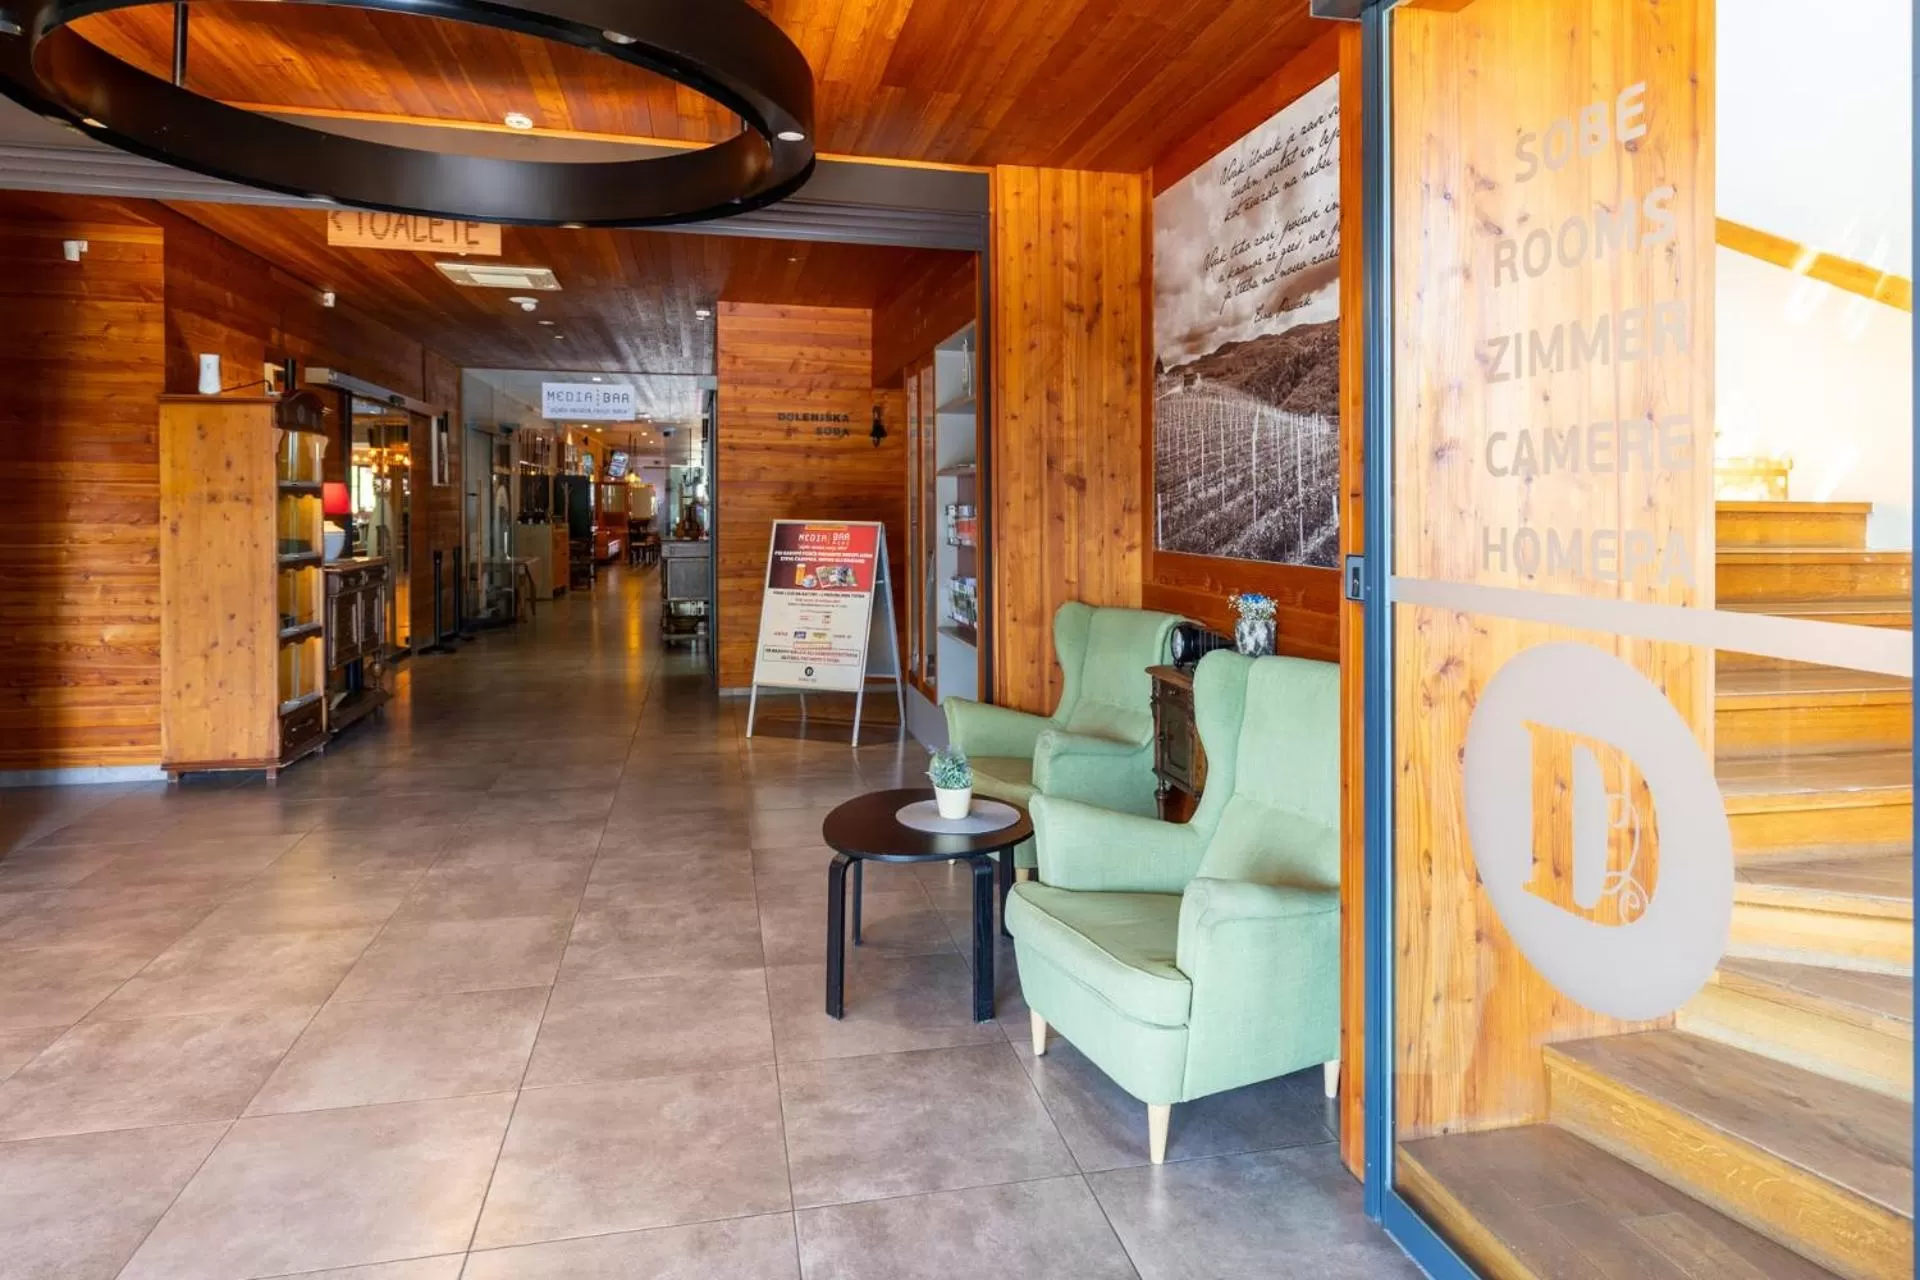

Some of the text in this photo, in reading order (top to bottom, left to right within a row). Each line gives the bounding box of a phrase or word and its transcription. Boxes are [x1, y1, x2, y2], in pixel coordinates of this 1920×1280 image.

[1514, 80, 1648, 184] SOBE
[1283, 176, 1299, 190] na
[357, 211, 480, 245] TOALETE
[1493, 185, 1677, 288] ROOMS
[1485, 301, 1691, 384] ZIMMER
[547, 391, 593, 403] MEDIA
[603, 392, 630, 404] BAR
[815, 426, 850, 437] SOBA
[1485, 414, 1694, 478] CAMERE
